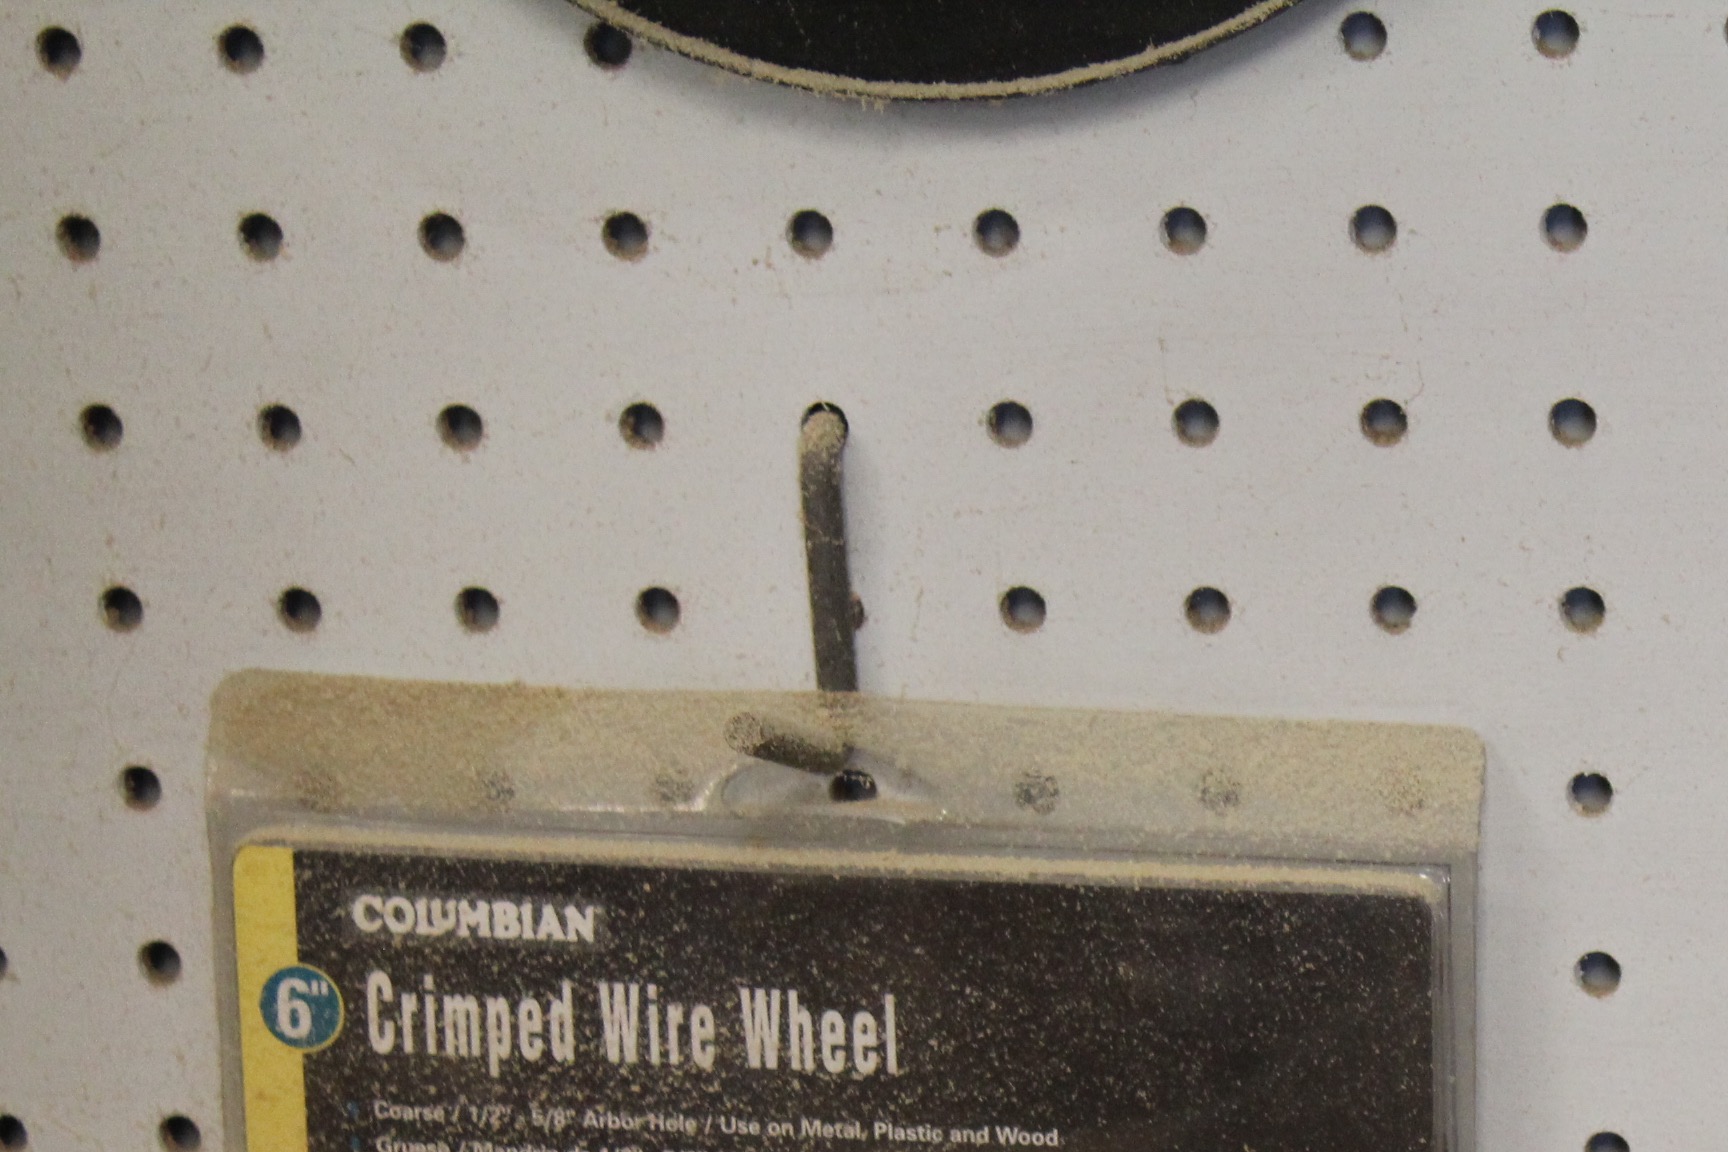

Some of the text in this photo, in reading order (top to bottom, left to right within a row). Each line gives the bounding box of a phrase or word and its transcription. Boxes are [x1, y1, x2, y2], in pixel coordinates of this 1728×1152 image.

[353, 895, 595, 943] COLUMBIAN
[275, 977, 329, 1040] 6"
[366, 970, 900, 1077] Crimped Wire Wheel
[374, 1100, 445, 1122] Coarse
[583, 1108, 640, 1131] Arbor
[651, 1111, 698, 1134] Hole
[720, 1115, 761, 1135] Use
[767, 1120, 794, 1137] on
[873, 1121, 943, 1144] Plastic
[950, 1124, 990, 1146] and
[996, 1126, 1059, 1147] Wood
